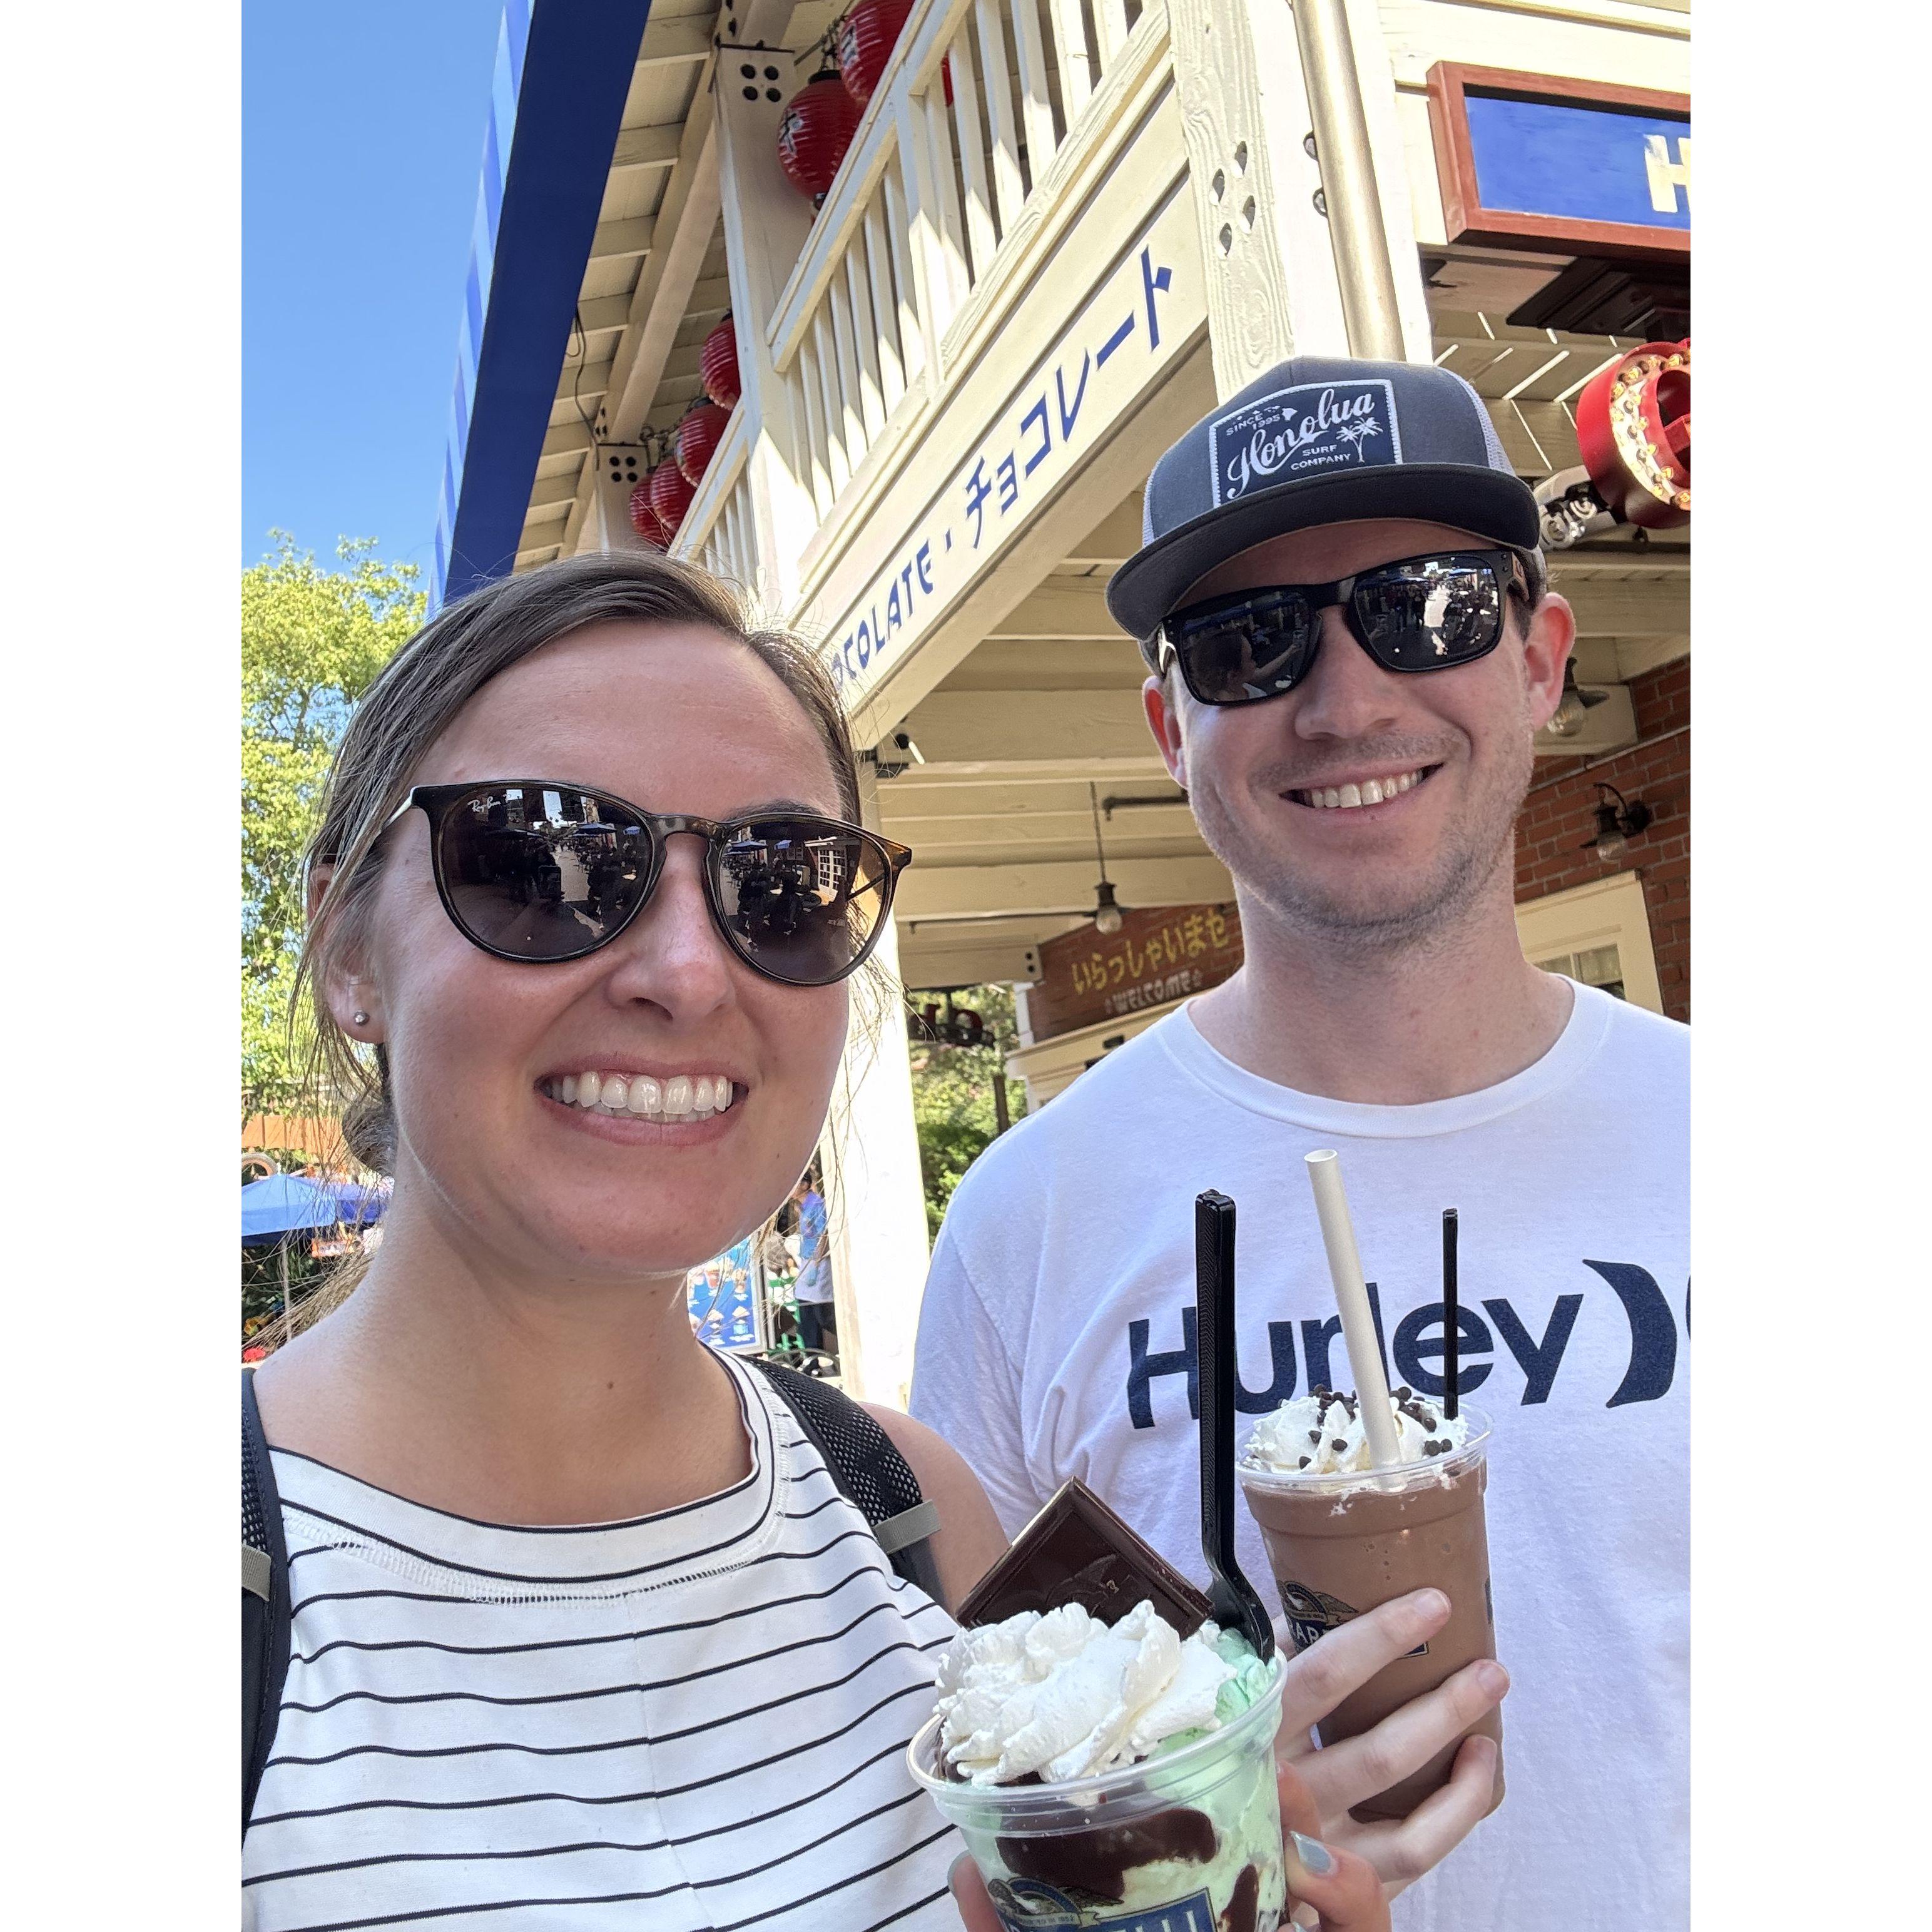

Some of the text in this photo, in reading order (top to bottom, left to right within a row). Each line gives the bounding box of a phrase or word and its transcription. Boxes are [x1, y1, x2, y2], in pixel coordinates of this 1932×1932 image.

[965, 244, 1172, 549] チョコレート
[1226, 413, 1263, 436] SINCE
[1253, 414, 1281, 430] 1995
[1227, 389, 1375, 499] Honolua
[1302, 444, 1337, 456] SURF
[1290, 453, 1351, 471] COMPANY
